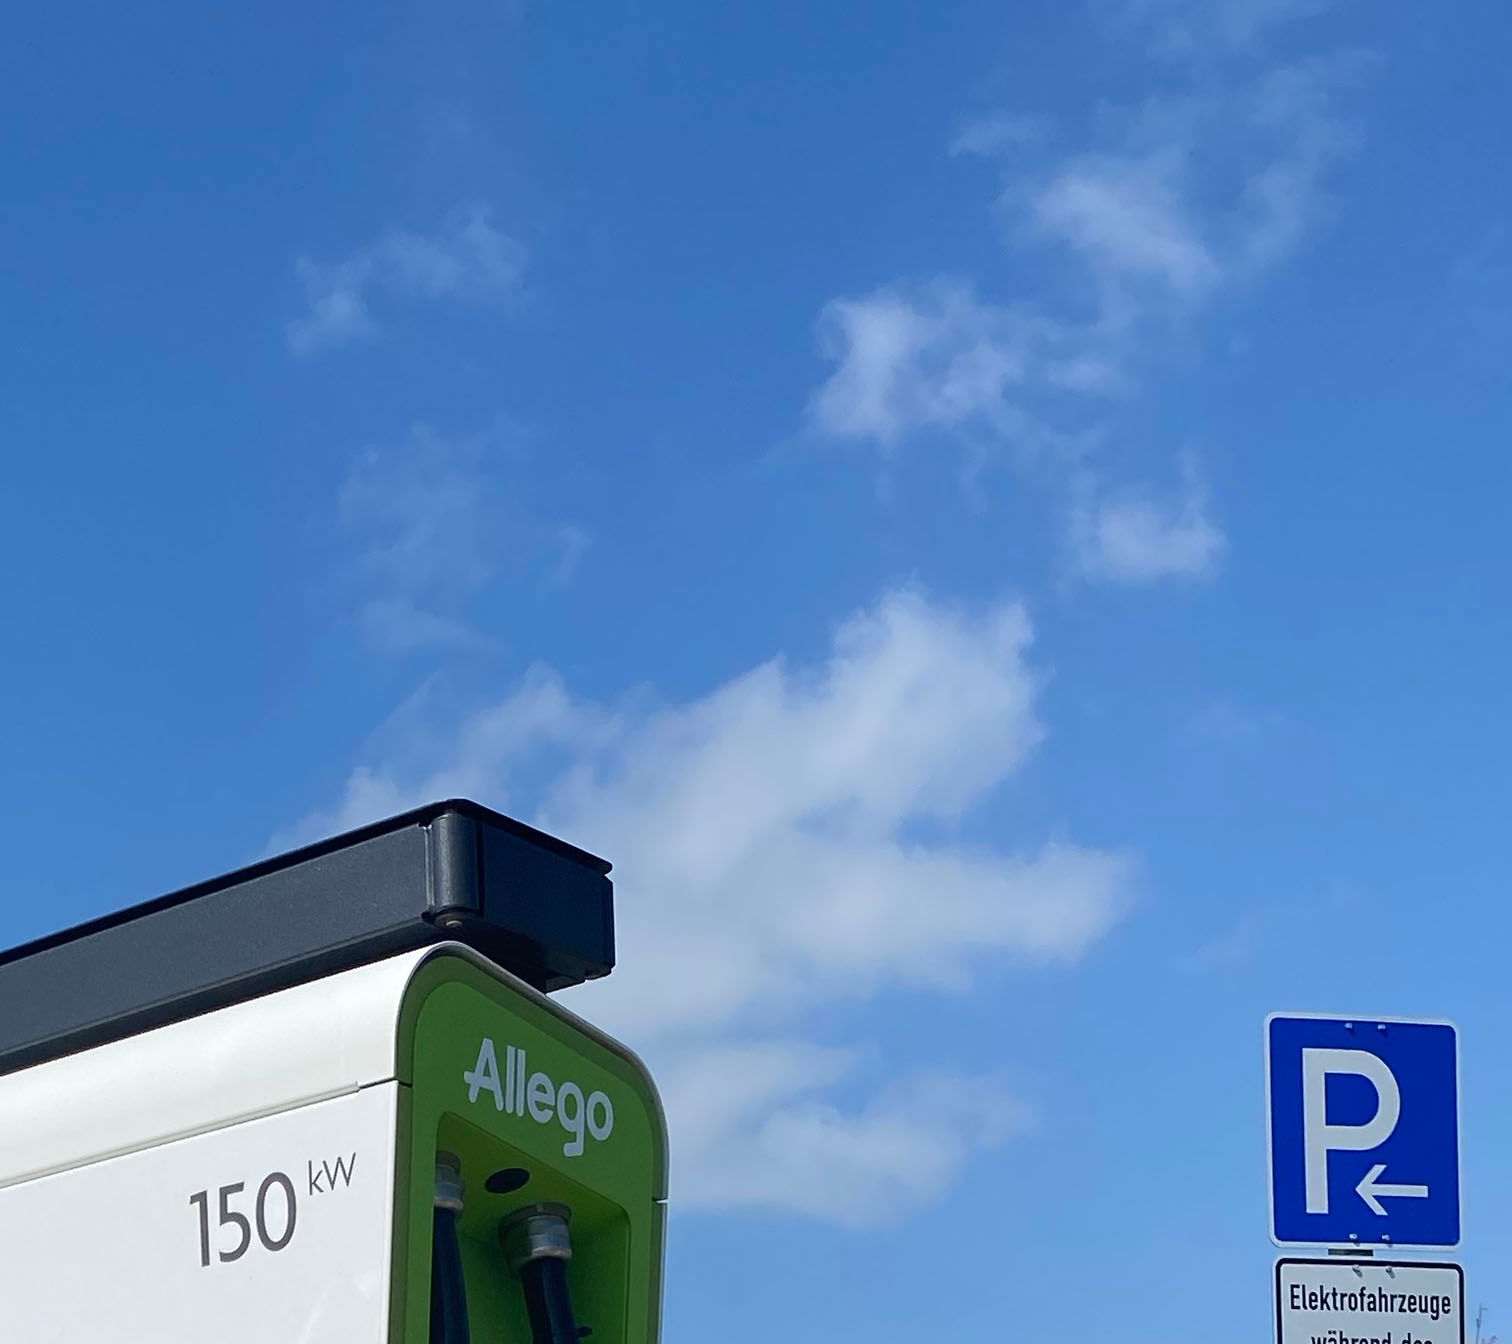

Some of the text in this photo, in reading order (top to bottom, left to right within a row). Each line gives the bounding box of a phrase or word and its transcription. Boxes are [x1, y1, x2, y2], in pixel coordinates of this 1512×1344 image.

[463, 1037, 615, 1157] Allego
[1302, 1047, 1401, 1215] P
[189, 1151, 357, 1268] 150 kW
[1289, 1283, 1452, 1321] Elektrofahrzeuge
